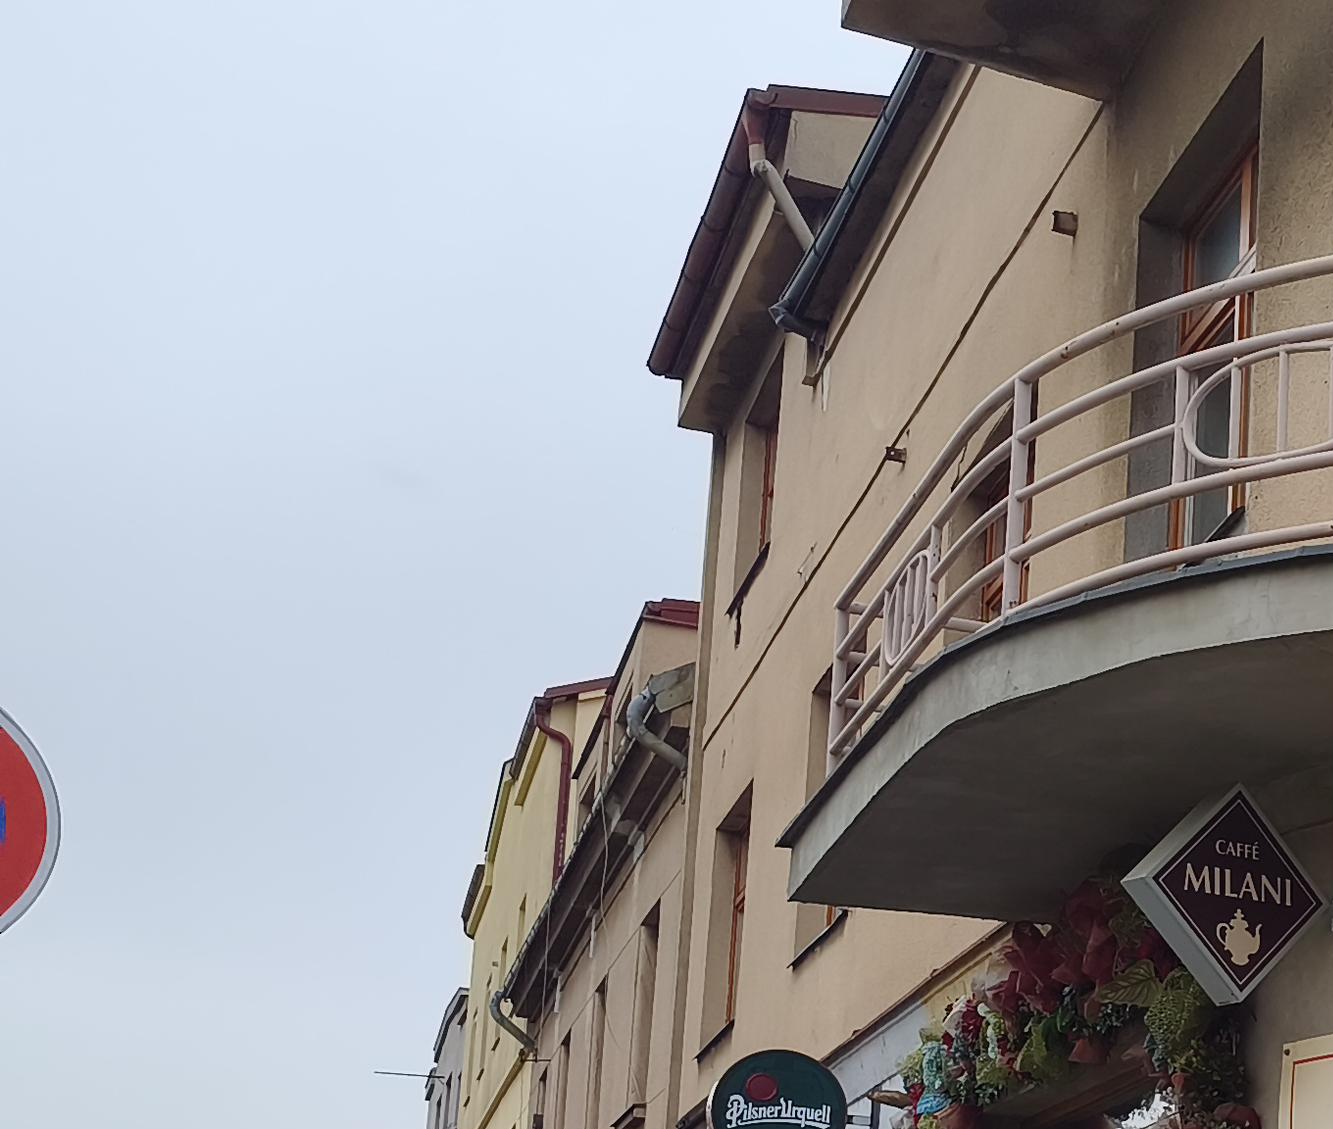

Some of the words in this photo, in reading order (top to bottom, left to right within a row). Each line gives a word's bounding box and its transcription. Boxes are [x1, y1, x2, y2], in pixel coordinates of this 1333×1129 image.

[1215, 839, 1260, 860] CAFFÉ
[1183, 862, 1292, 907] MILANI
[725, 1094, 780, 1129] Pilsner
[780, 1097, 831, 1129] Urquell
